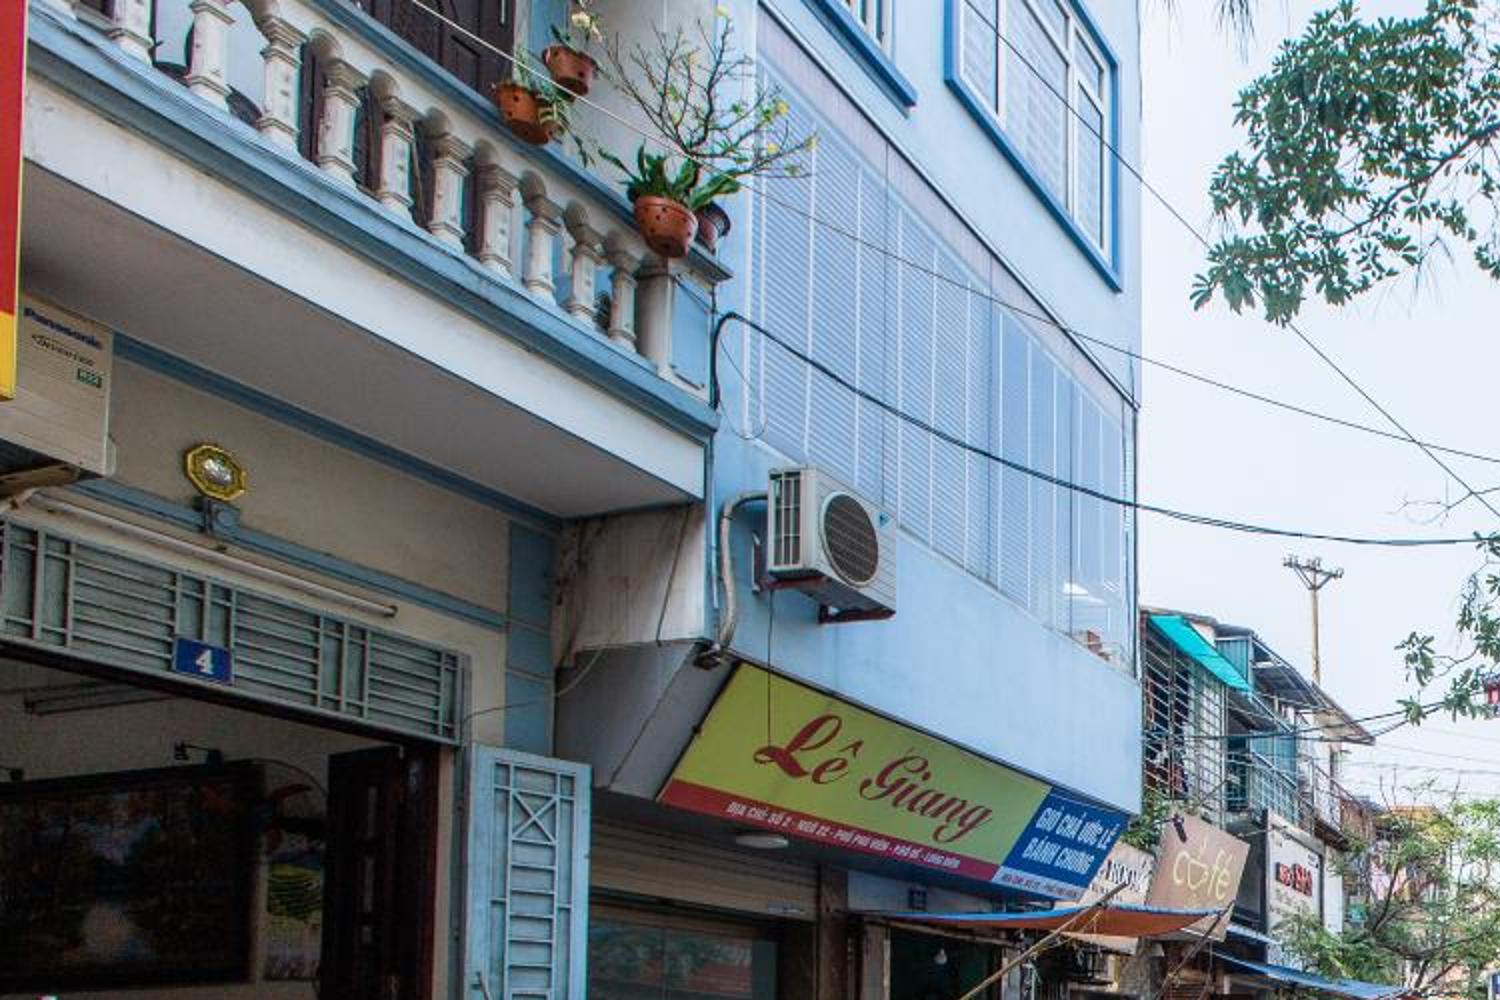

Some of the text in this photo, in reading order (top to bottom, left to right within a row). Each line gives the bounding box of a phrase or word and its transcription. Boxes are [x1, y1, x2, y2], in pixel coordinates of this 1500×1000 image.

[195, 649, 214, 675] 4
[754, 715, 993, 843] Lê Giang
